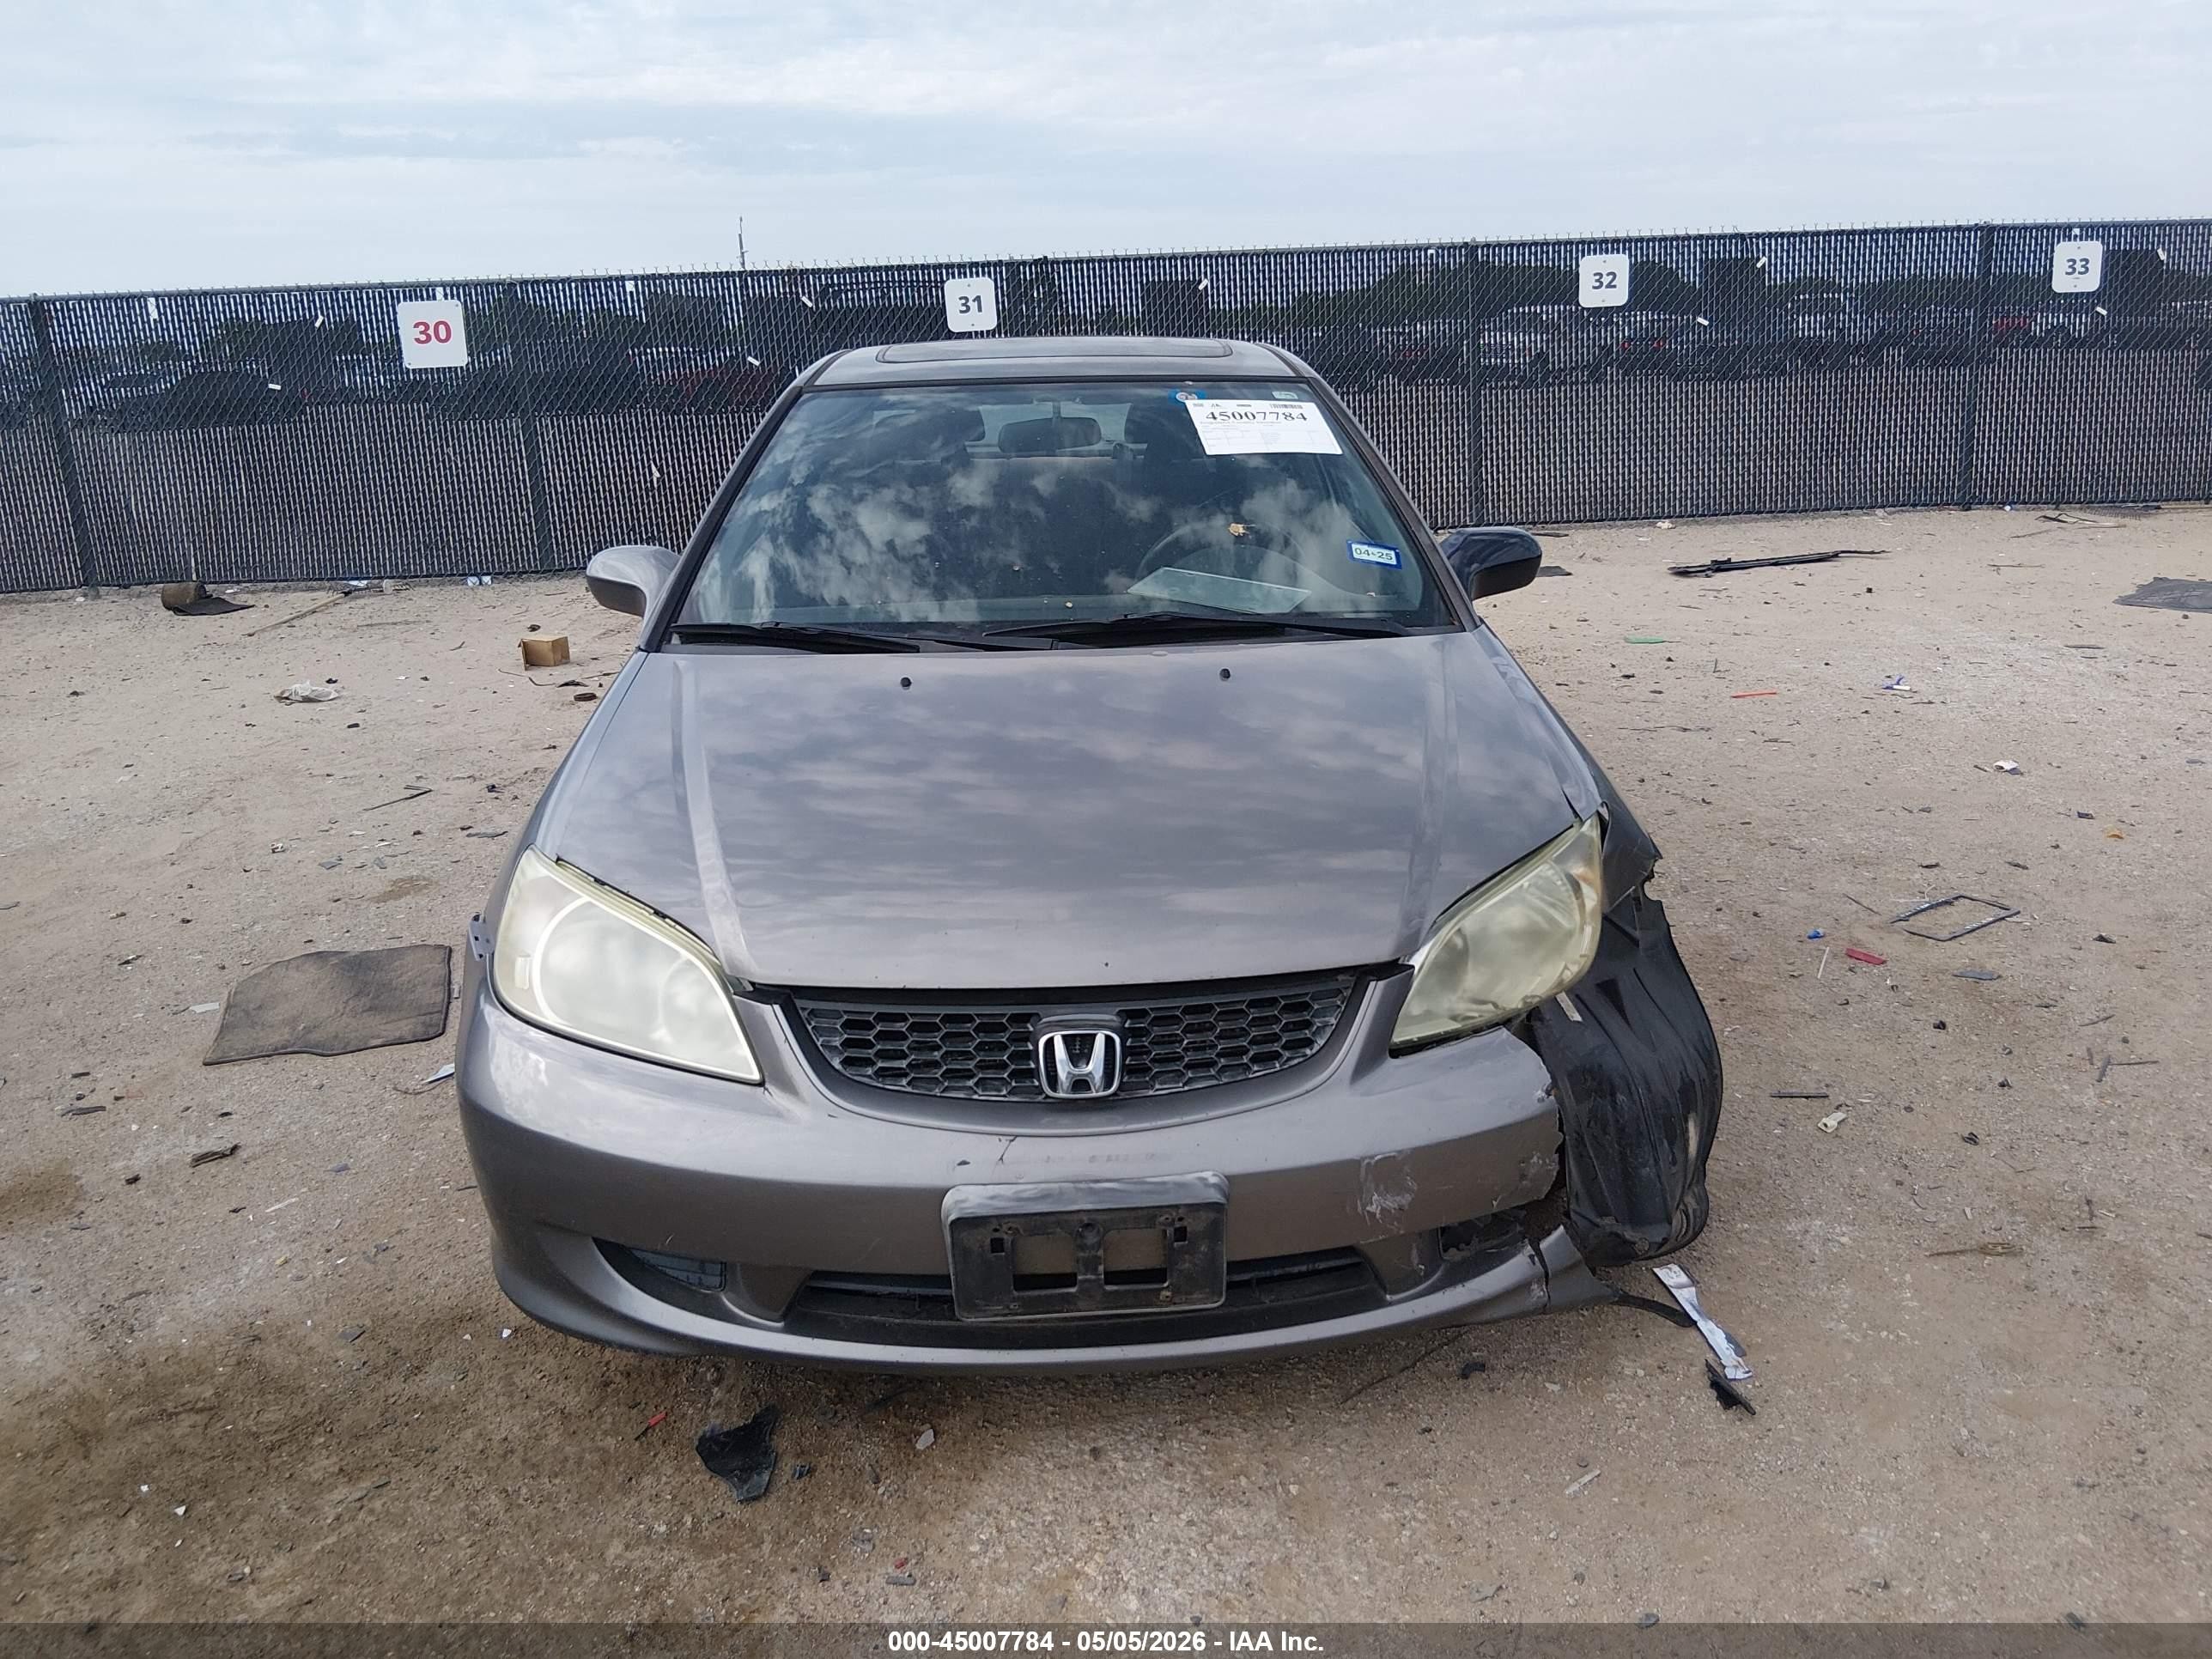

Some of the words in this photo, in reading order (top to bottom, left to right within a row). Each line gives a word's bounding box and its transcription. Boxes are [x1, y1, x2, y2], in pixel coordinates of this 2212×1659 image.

[2064, 258, 2090, 276] 33
[1591, 270, 1617, 289] 32
[958, 295, 983, 314] 31
[412, 320, 452, 344] 30
[1206, 411, 1308, 422] 45007784
